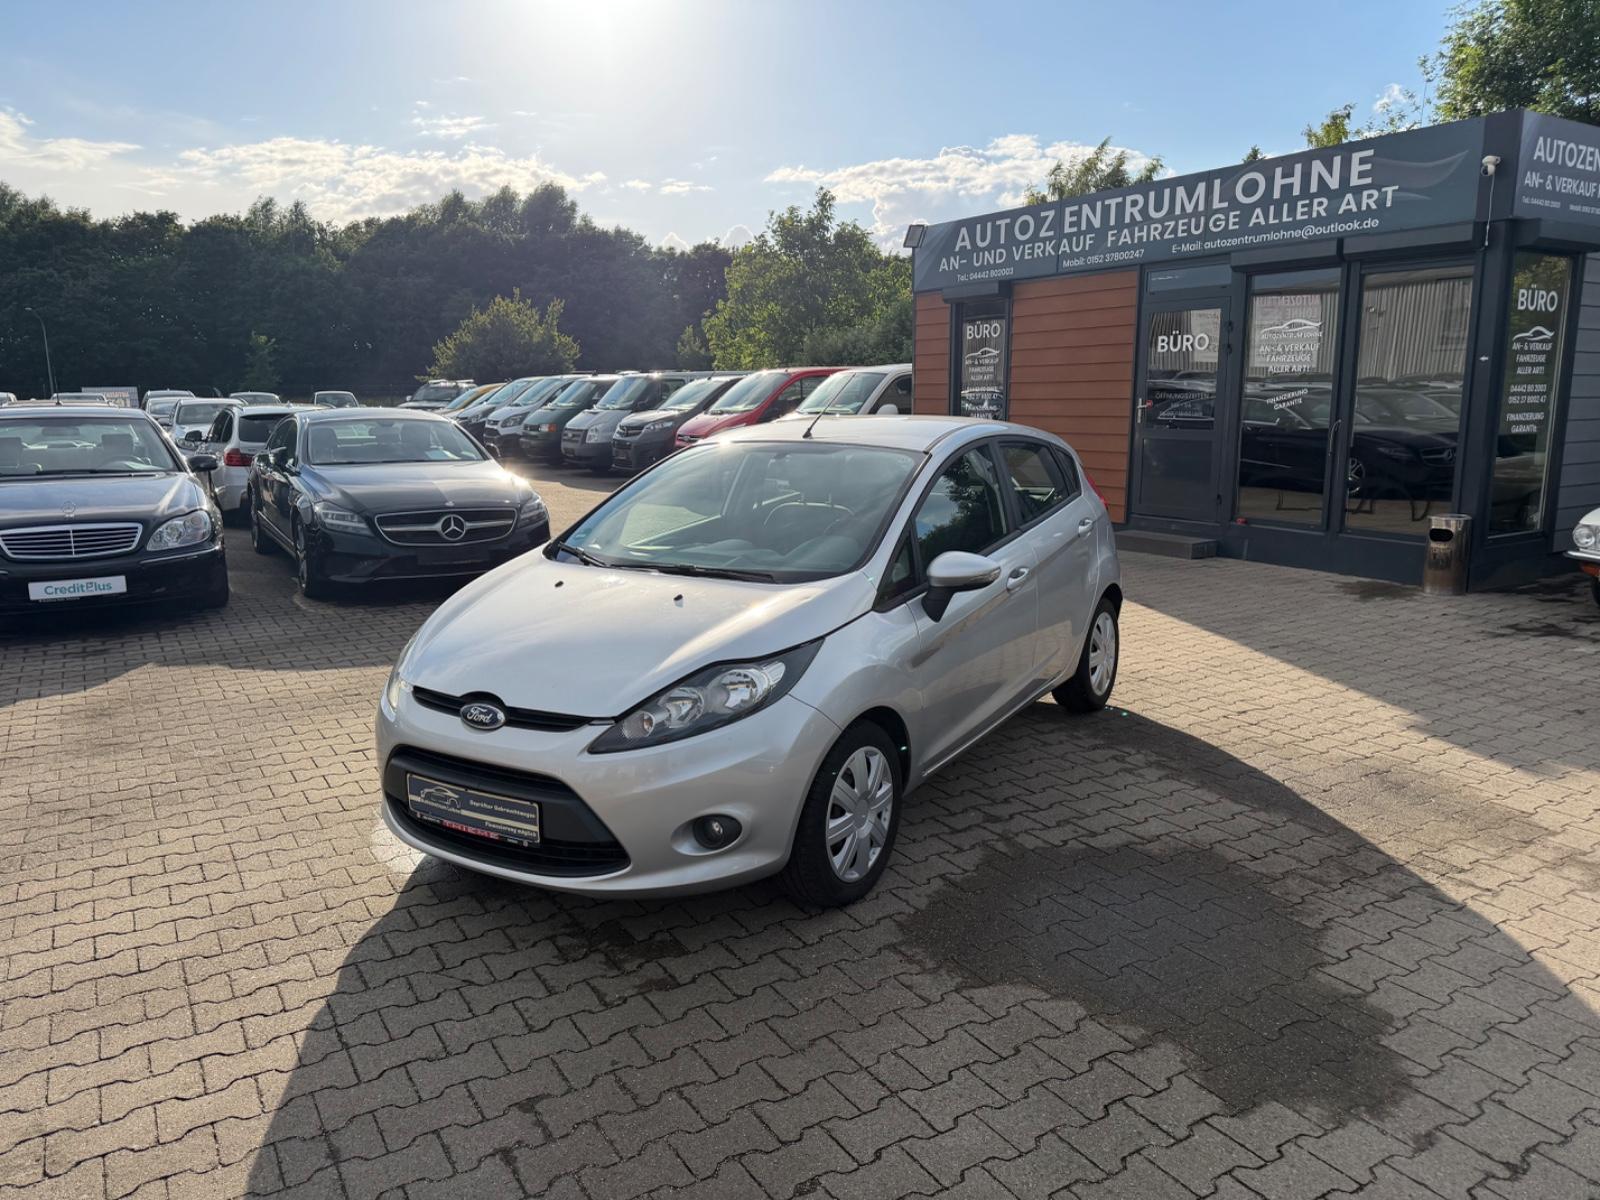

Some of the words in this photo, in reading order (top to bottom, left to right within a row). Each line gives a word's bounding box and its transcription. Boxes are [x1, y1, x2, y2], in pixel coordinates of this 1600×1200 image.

[1524, 170, 1544, 188] AN-
[1545, 174, 1553, 191] &
[1555, 175, 1598, 198] VERKAUF
[939, 253, 968, 273] AN-
[973, 248, 1007, 268] UND
[1012, 233, 1096, 262] VERKAUF
[1107, 210, 1241, 248] FAHRZEUGE
[1248, 197, 1328, 228] ALLER
[1338, 184, 1399, 215] ART
[1203, 217, 1379, 250] autozentrumlohne@outlook.de
[1086, 254, 1104, 265] 0152
[1105, 248, 1145, 262] 37800247
[969, 269, 989, 281] 04442
[1516, 283, 1558, 312] BÜRO
[966, 320, 1001, 340] BÜRO
[1157, 330, 1210, 353] BÜRO
[44, 582, 113, 595] CreditPlus
[466, 706, 493, 724] Ford
